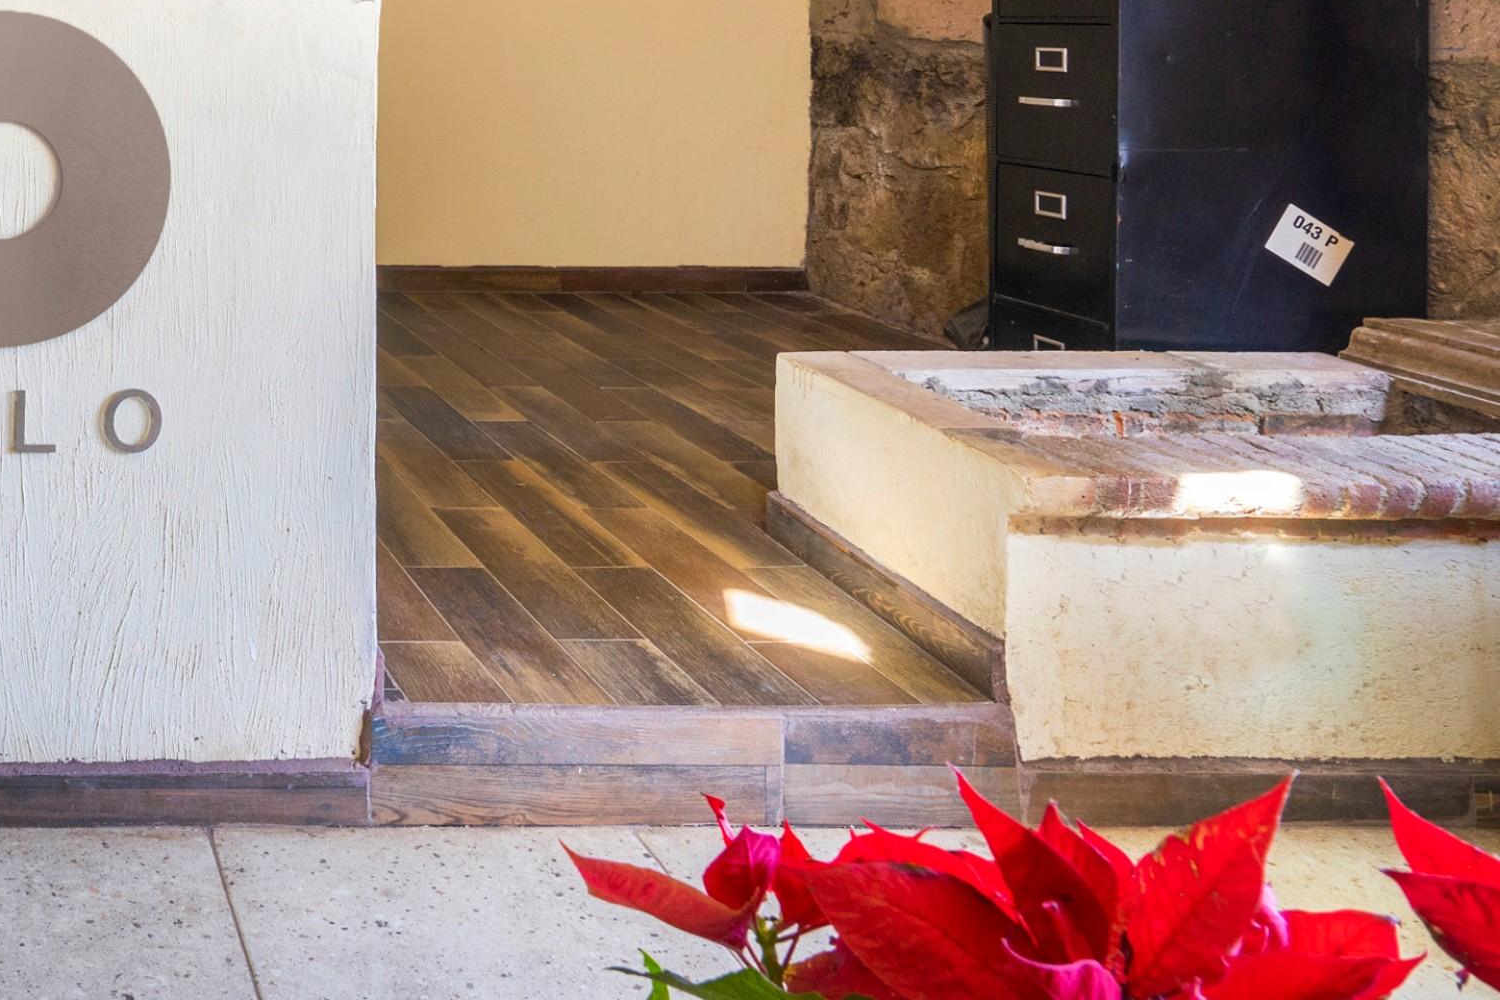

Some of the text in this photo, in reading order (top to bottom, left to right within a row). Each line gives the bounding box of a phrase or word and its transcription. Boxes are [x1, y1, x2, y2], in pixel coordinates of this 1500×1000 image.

[1293, 215, 1339, 247] 043 P
[102, 388, 162, 454] O
